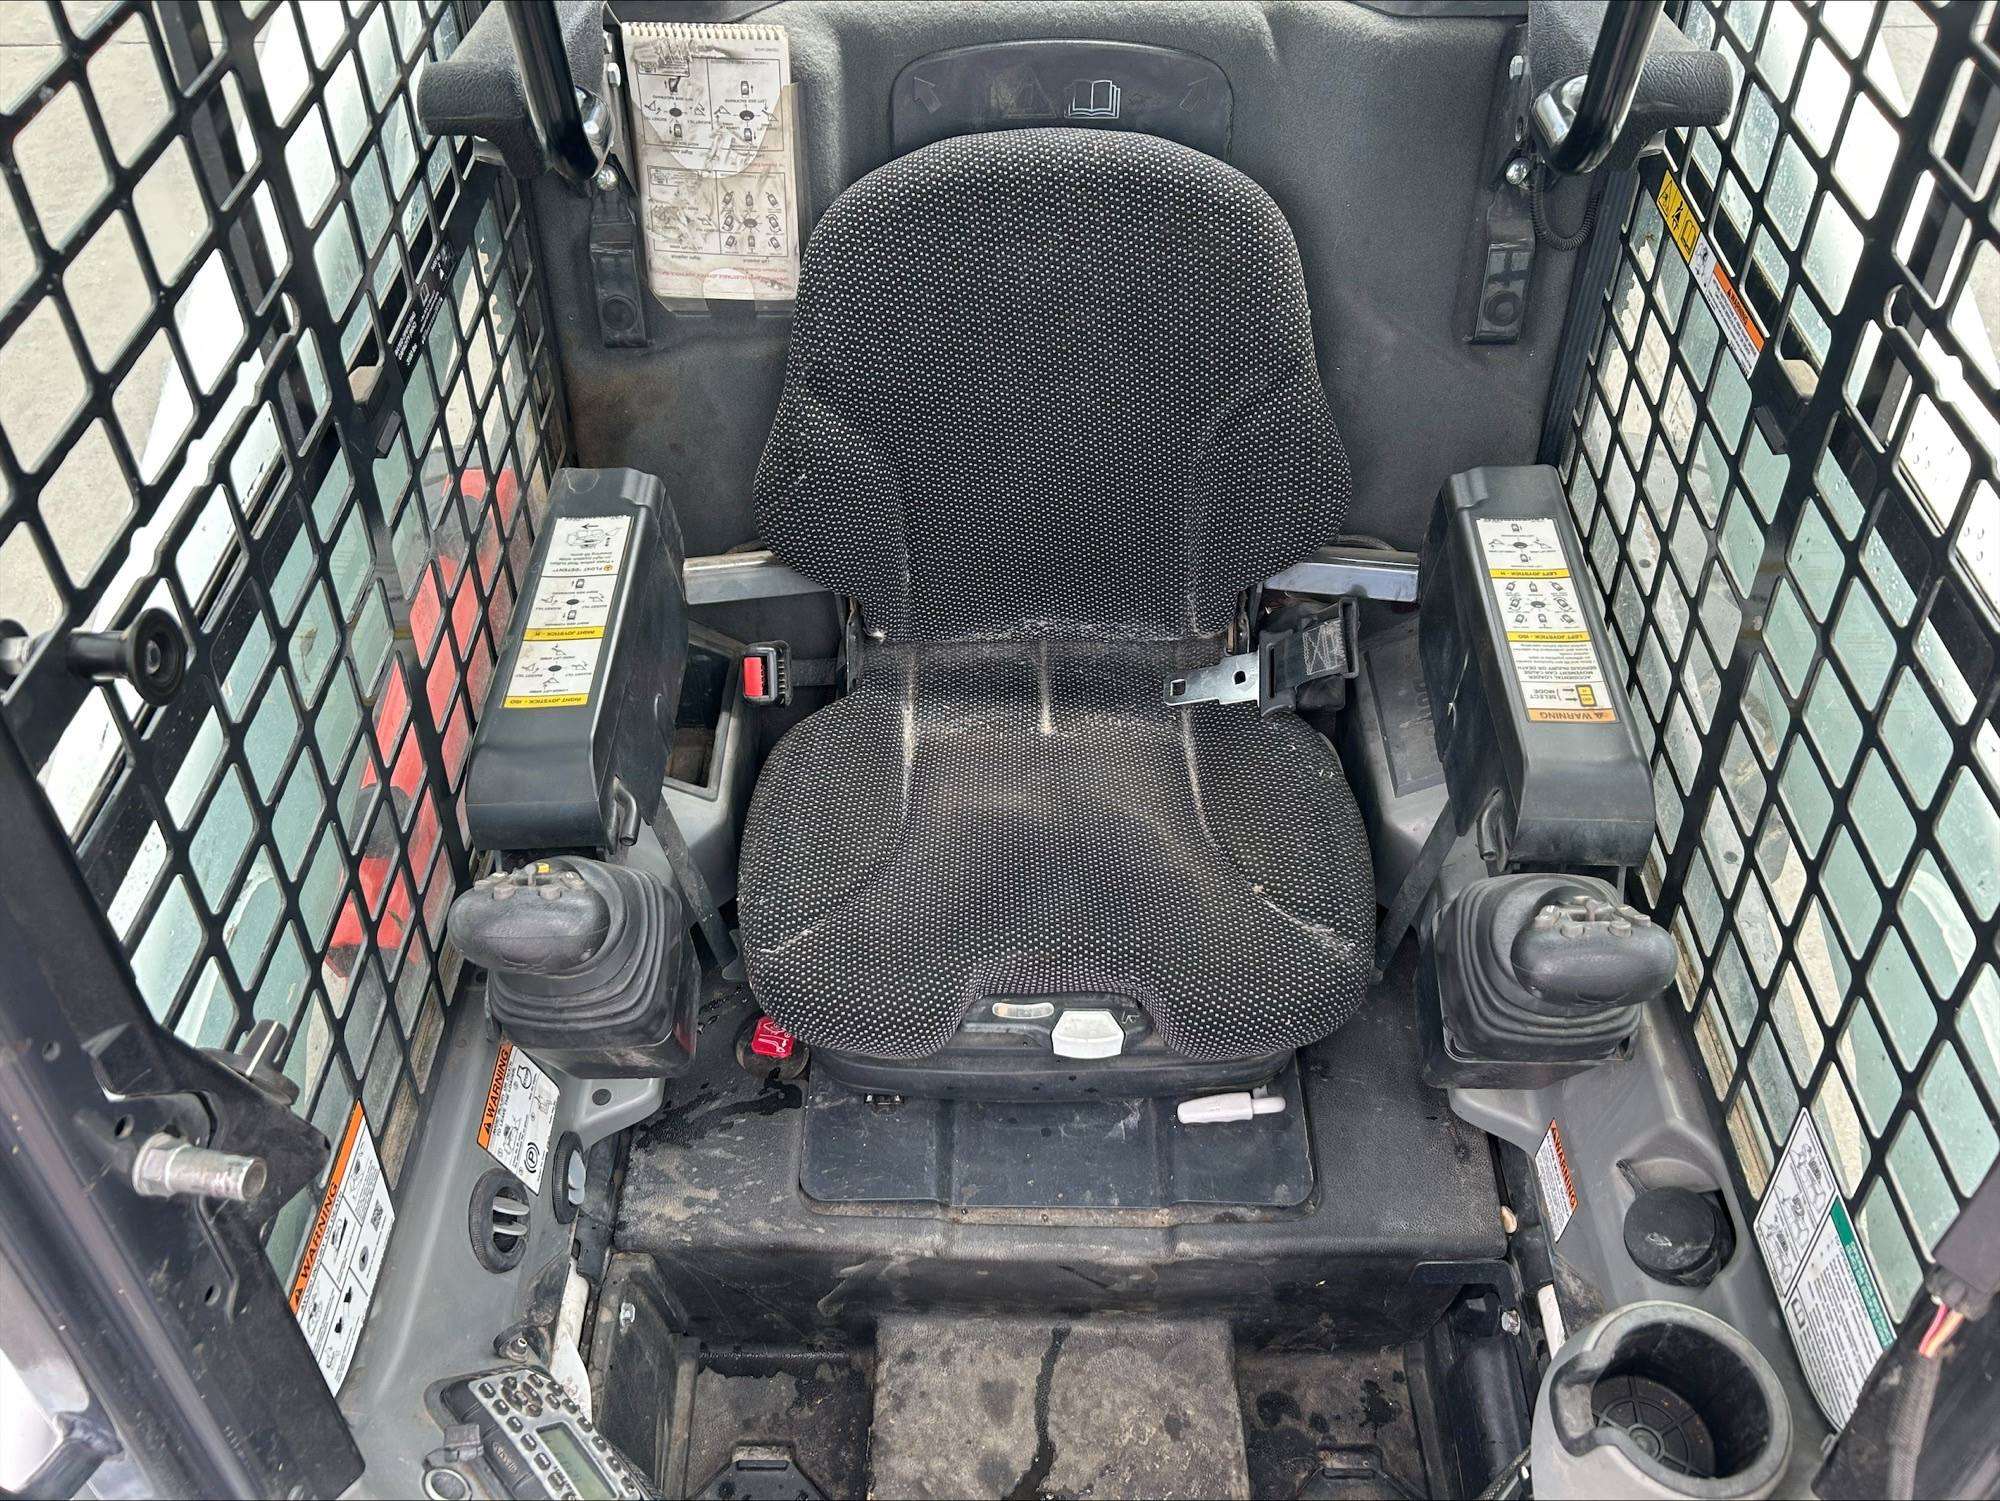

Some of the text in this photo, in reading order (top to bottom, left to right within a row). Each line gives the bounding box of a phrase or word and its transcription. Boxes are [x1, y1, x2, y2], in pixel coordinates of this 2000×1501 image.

[1538, 711, 1592, 719] WARNING
[485, 1048, 509, 1118] WARNING
[1555, 1137, 1576, 1206] WARNING
[301, 1182, 338, 1279] WARNING
